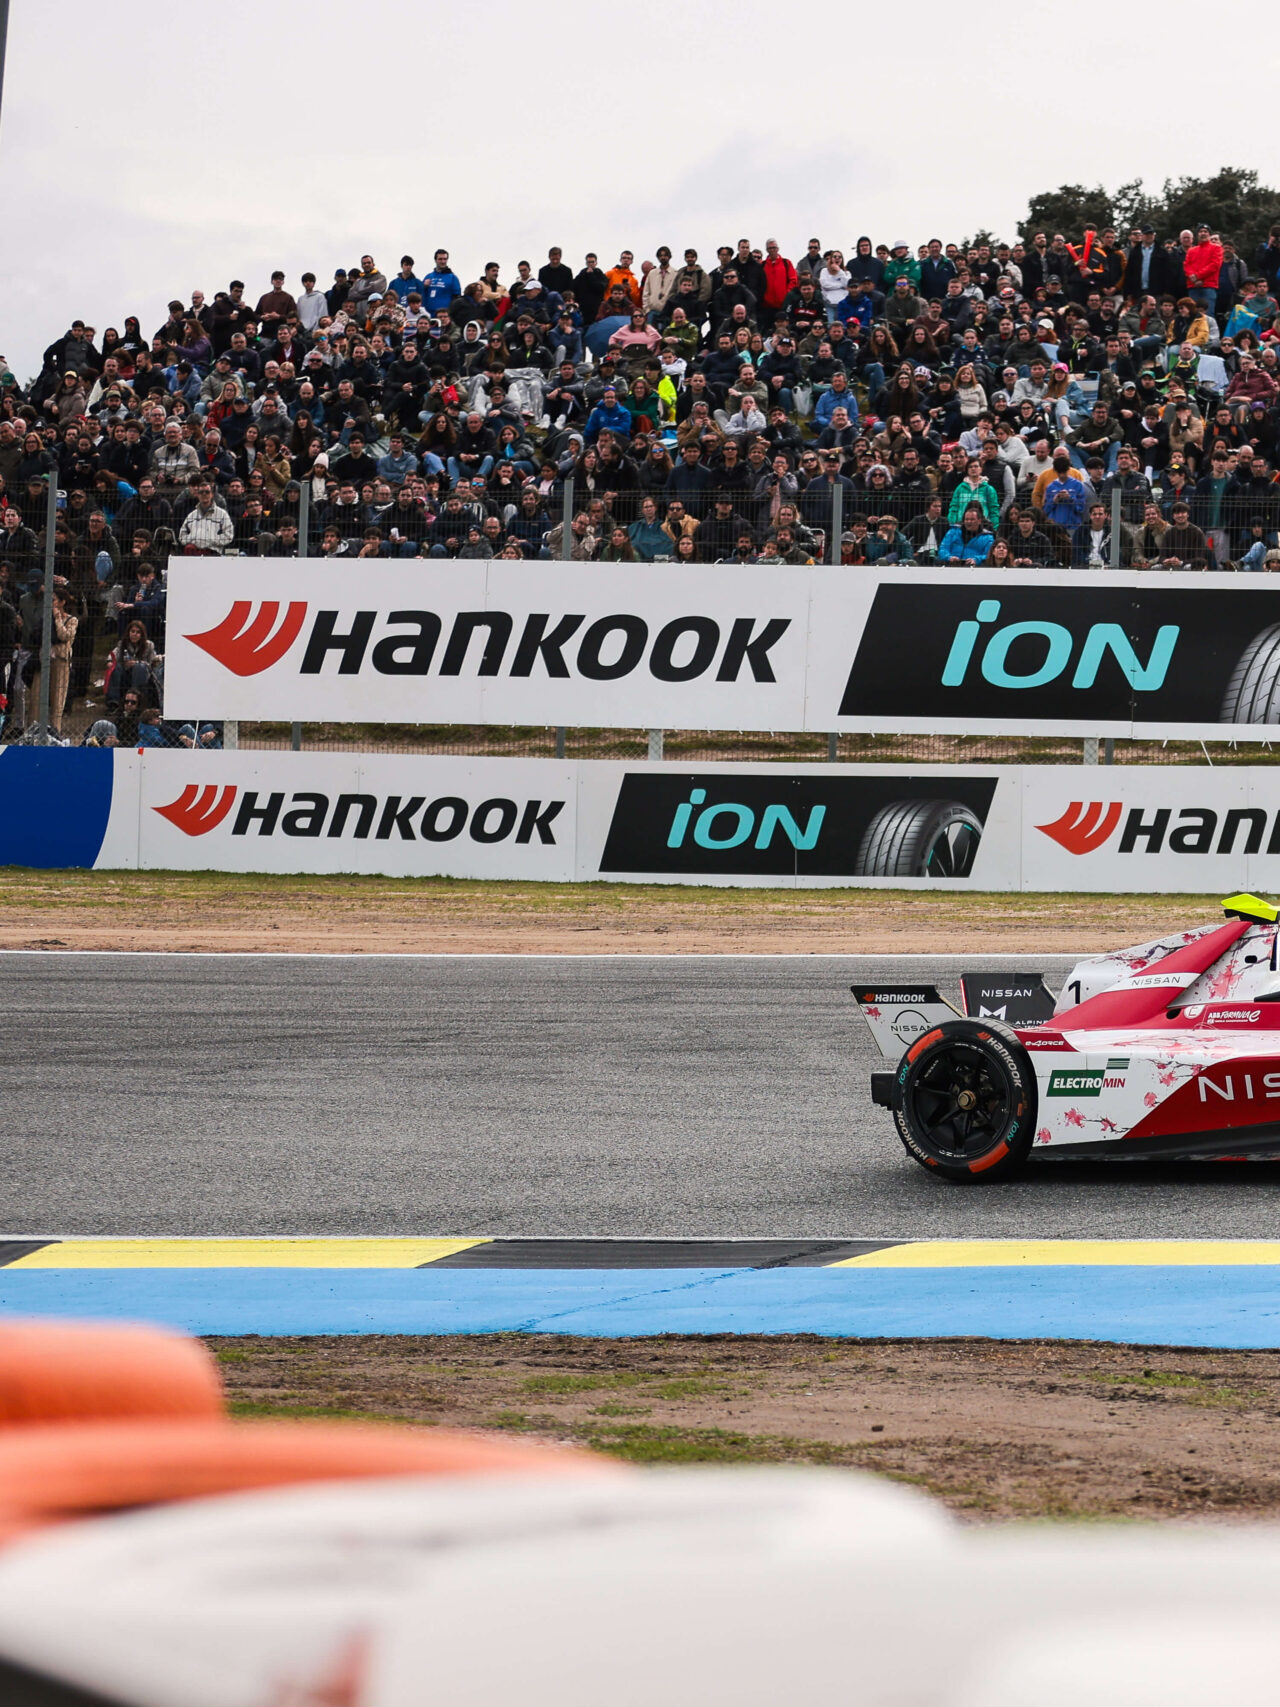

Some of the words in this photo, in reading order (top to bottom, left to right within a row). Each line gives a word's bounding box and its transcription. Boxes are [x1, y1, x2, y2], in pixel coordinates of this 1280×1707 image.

[941, 600, 1180, 691] iON
[667, 789, 827, 850] iON
[981, 989, 1032, 998] NISSAN
[1068, 980, 1081, 1005] 1
[1131, 976, 1181, 986] NISSAN
